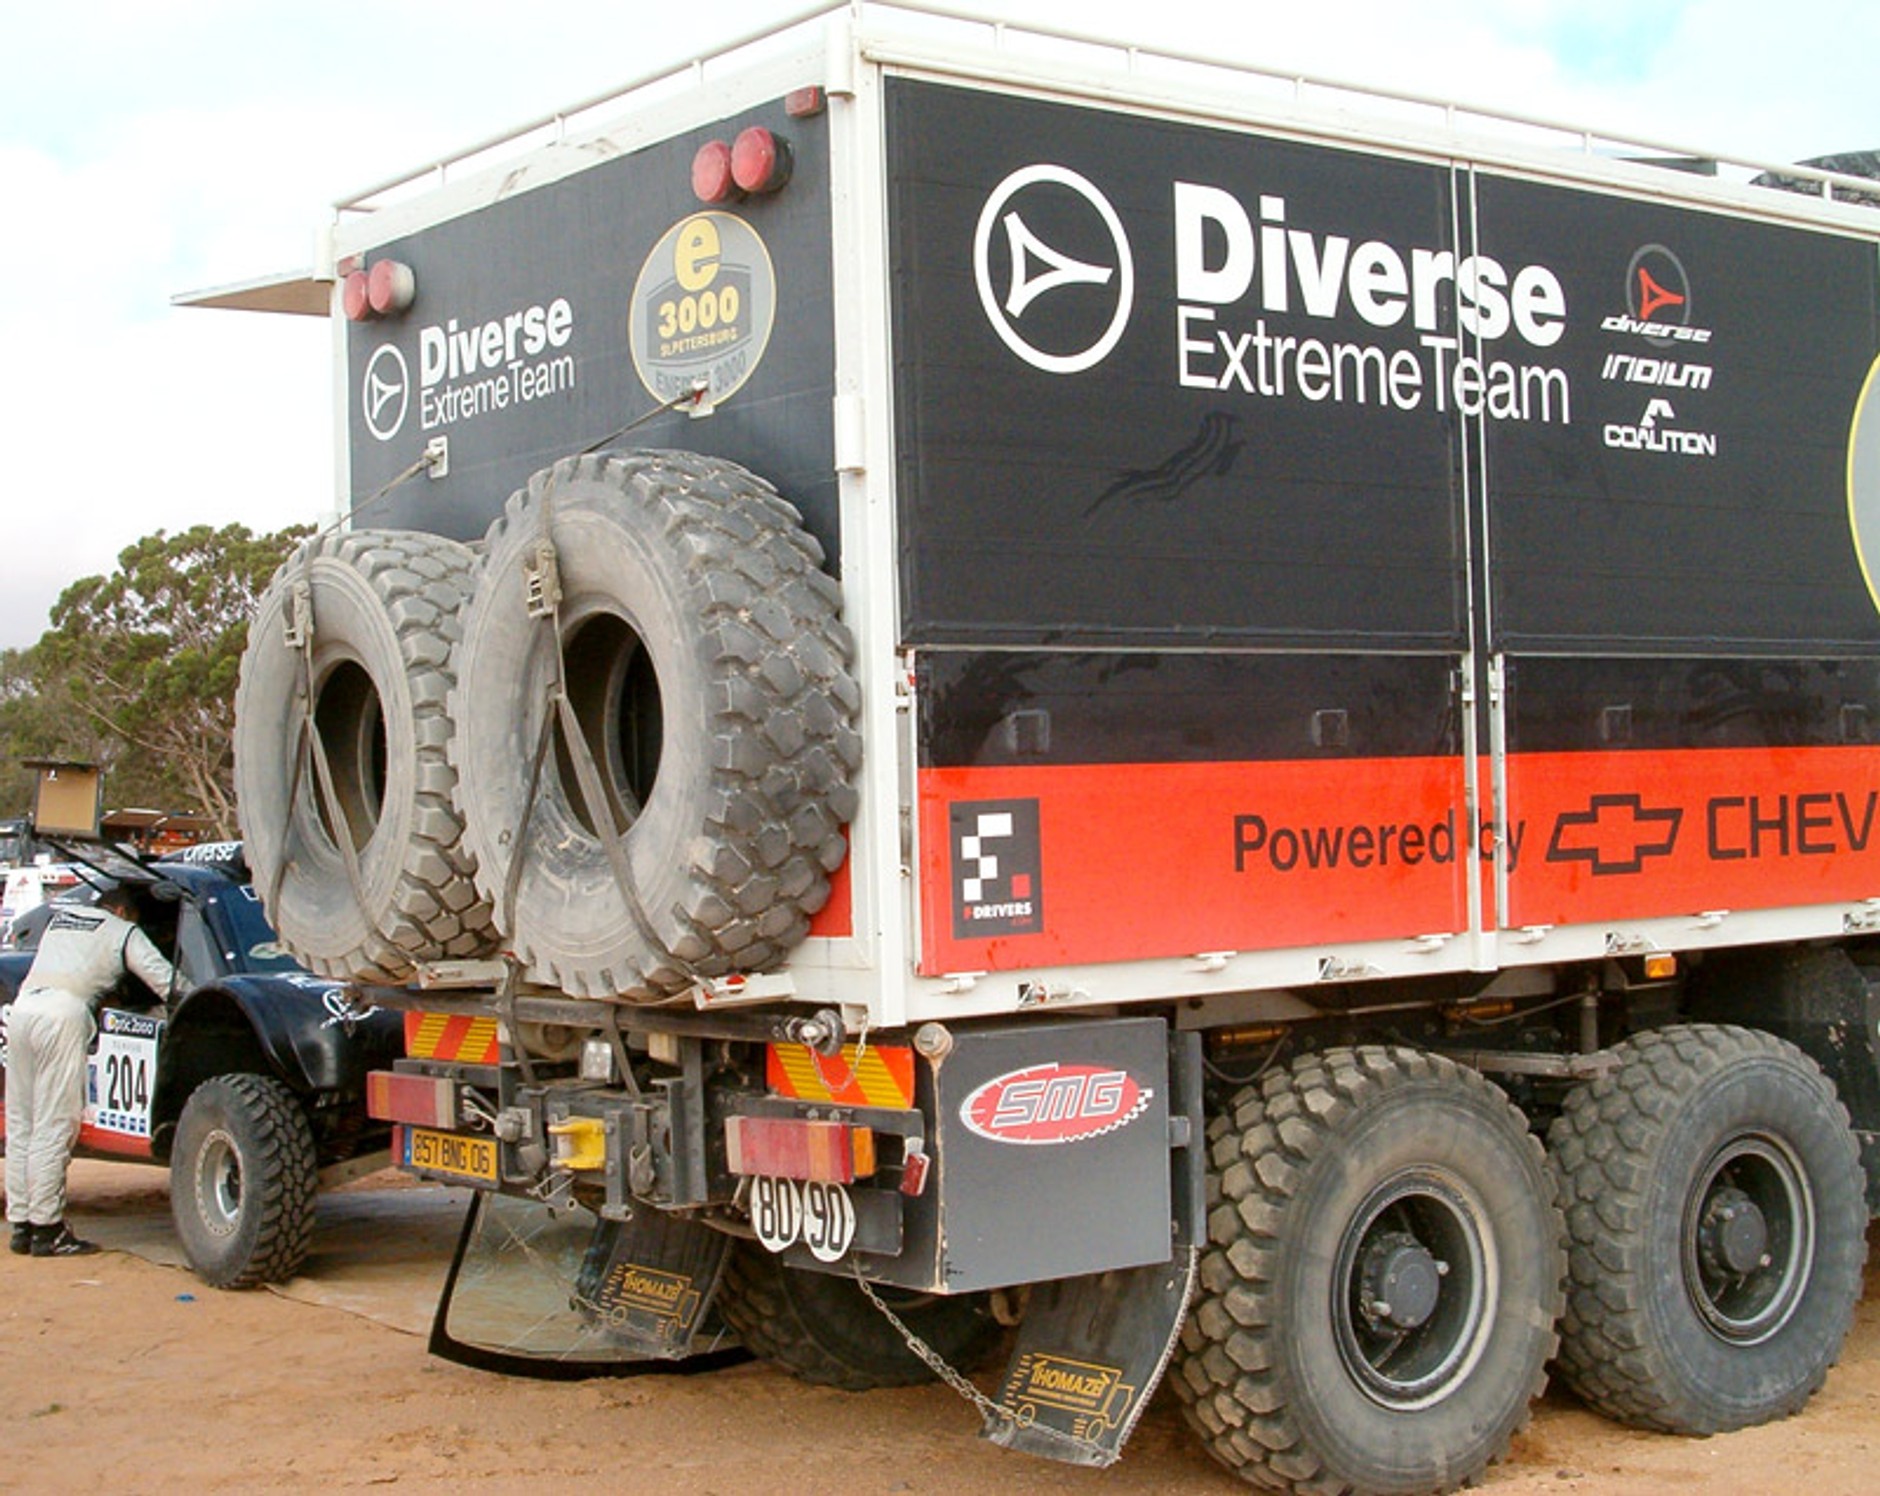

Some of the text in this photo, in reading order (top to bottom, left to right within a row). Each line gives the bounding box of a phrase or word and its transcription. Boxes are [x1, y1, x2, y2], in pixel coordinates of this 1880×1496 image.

[675, 217, 721, 292] e
[1174, 180, 1568, 348] Diverse
[420, 298, 574, 389] Diverse
[658, 285, 739, 339] 3000
[1601, 314, 1713, 343] diverse
[1604, 424, 1718, 457] COALITION
[1233, 807, 1456, 873] Powered
[1707, 791, 1879, 861] CHEV
[106, 1054, 148, 1112] 204
[991, 1071, 1127, 1129] SMG
[471, 1143, 490, 1174] 06
[758, 1175, 794, 1243] 80
[808, 1181, 846, 1253] 90
